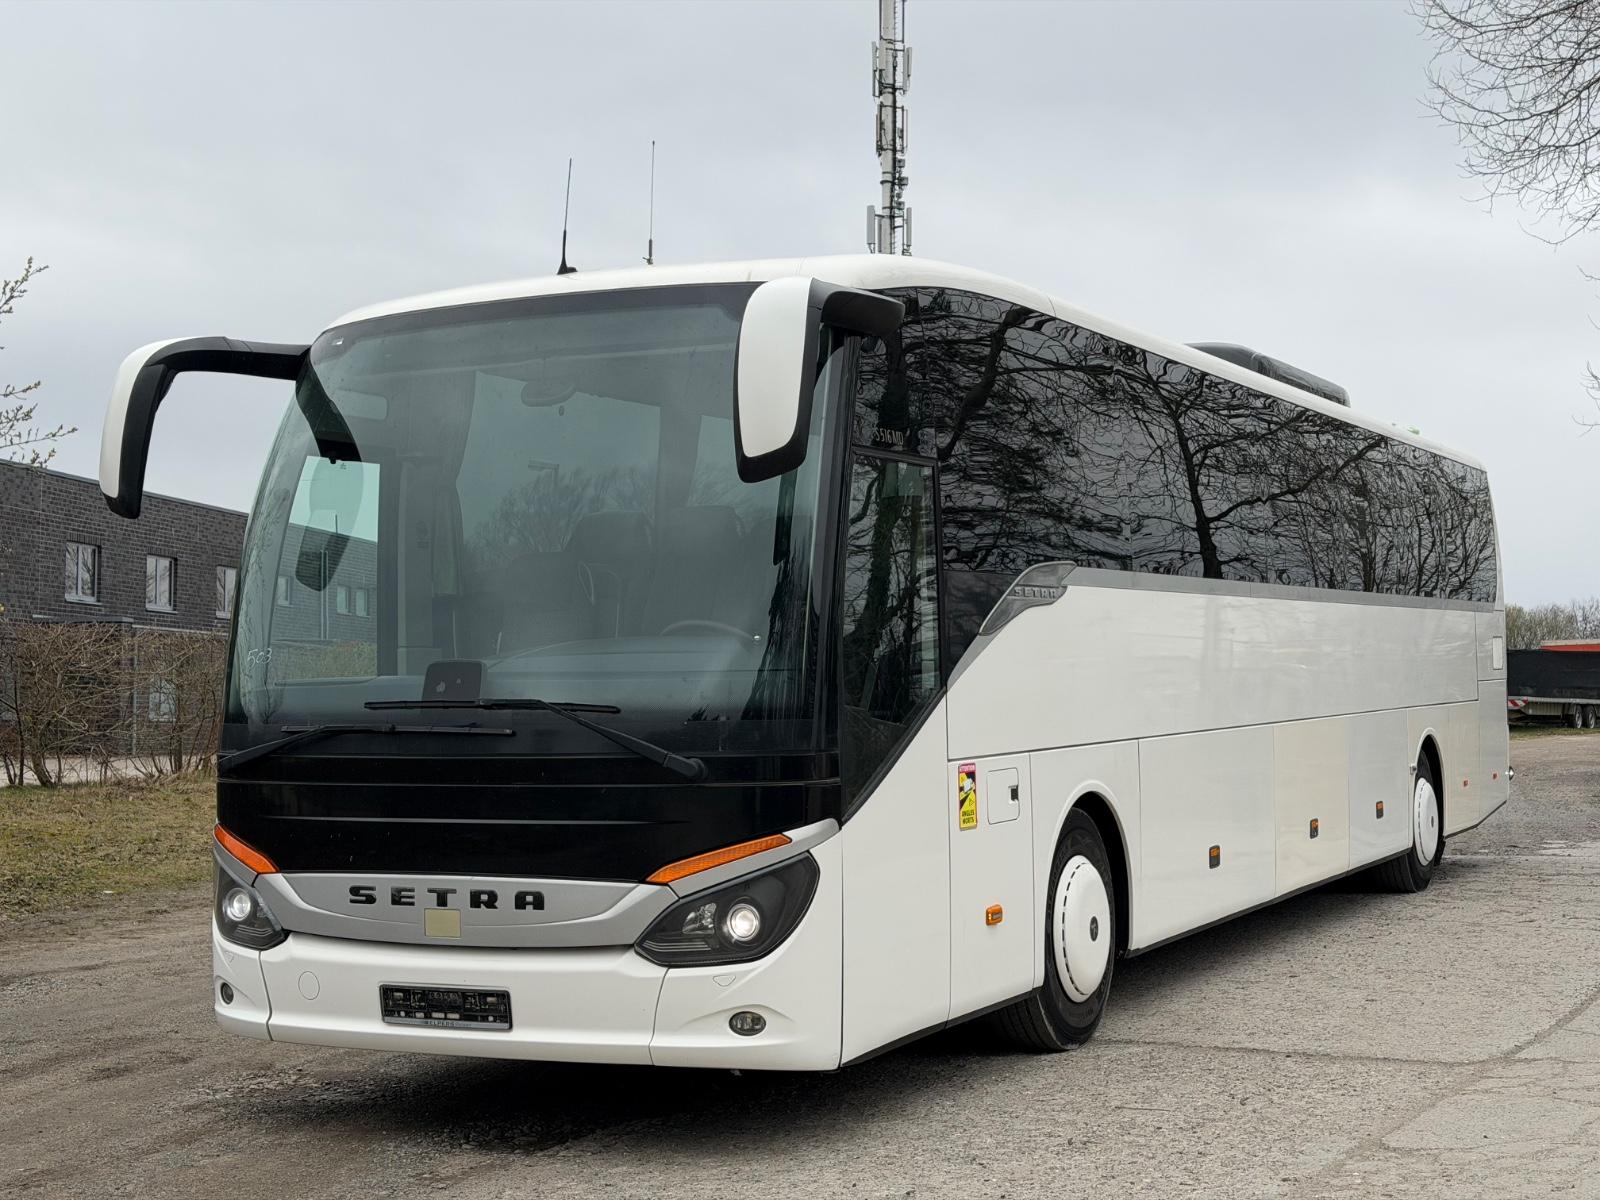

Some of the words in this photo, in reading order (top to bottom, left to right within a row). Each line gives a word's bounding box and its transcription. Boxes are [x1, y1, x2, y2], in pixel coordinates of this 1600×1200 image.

[1014, 586, 1057, 599] SETRA
[247, 647, 273, 668] 503
[349, 885, 545, 911] SETRA
